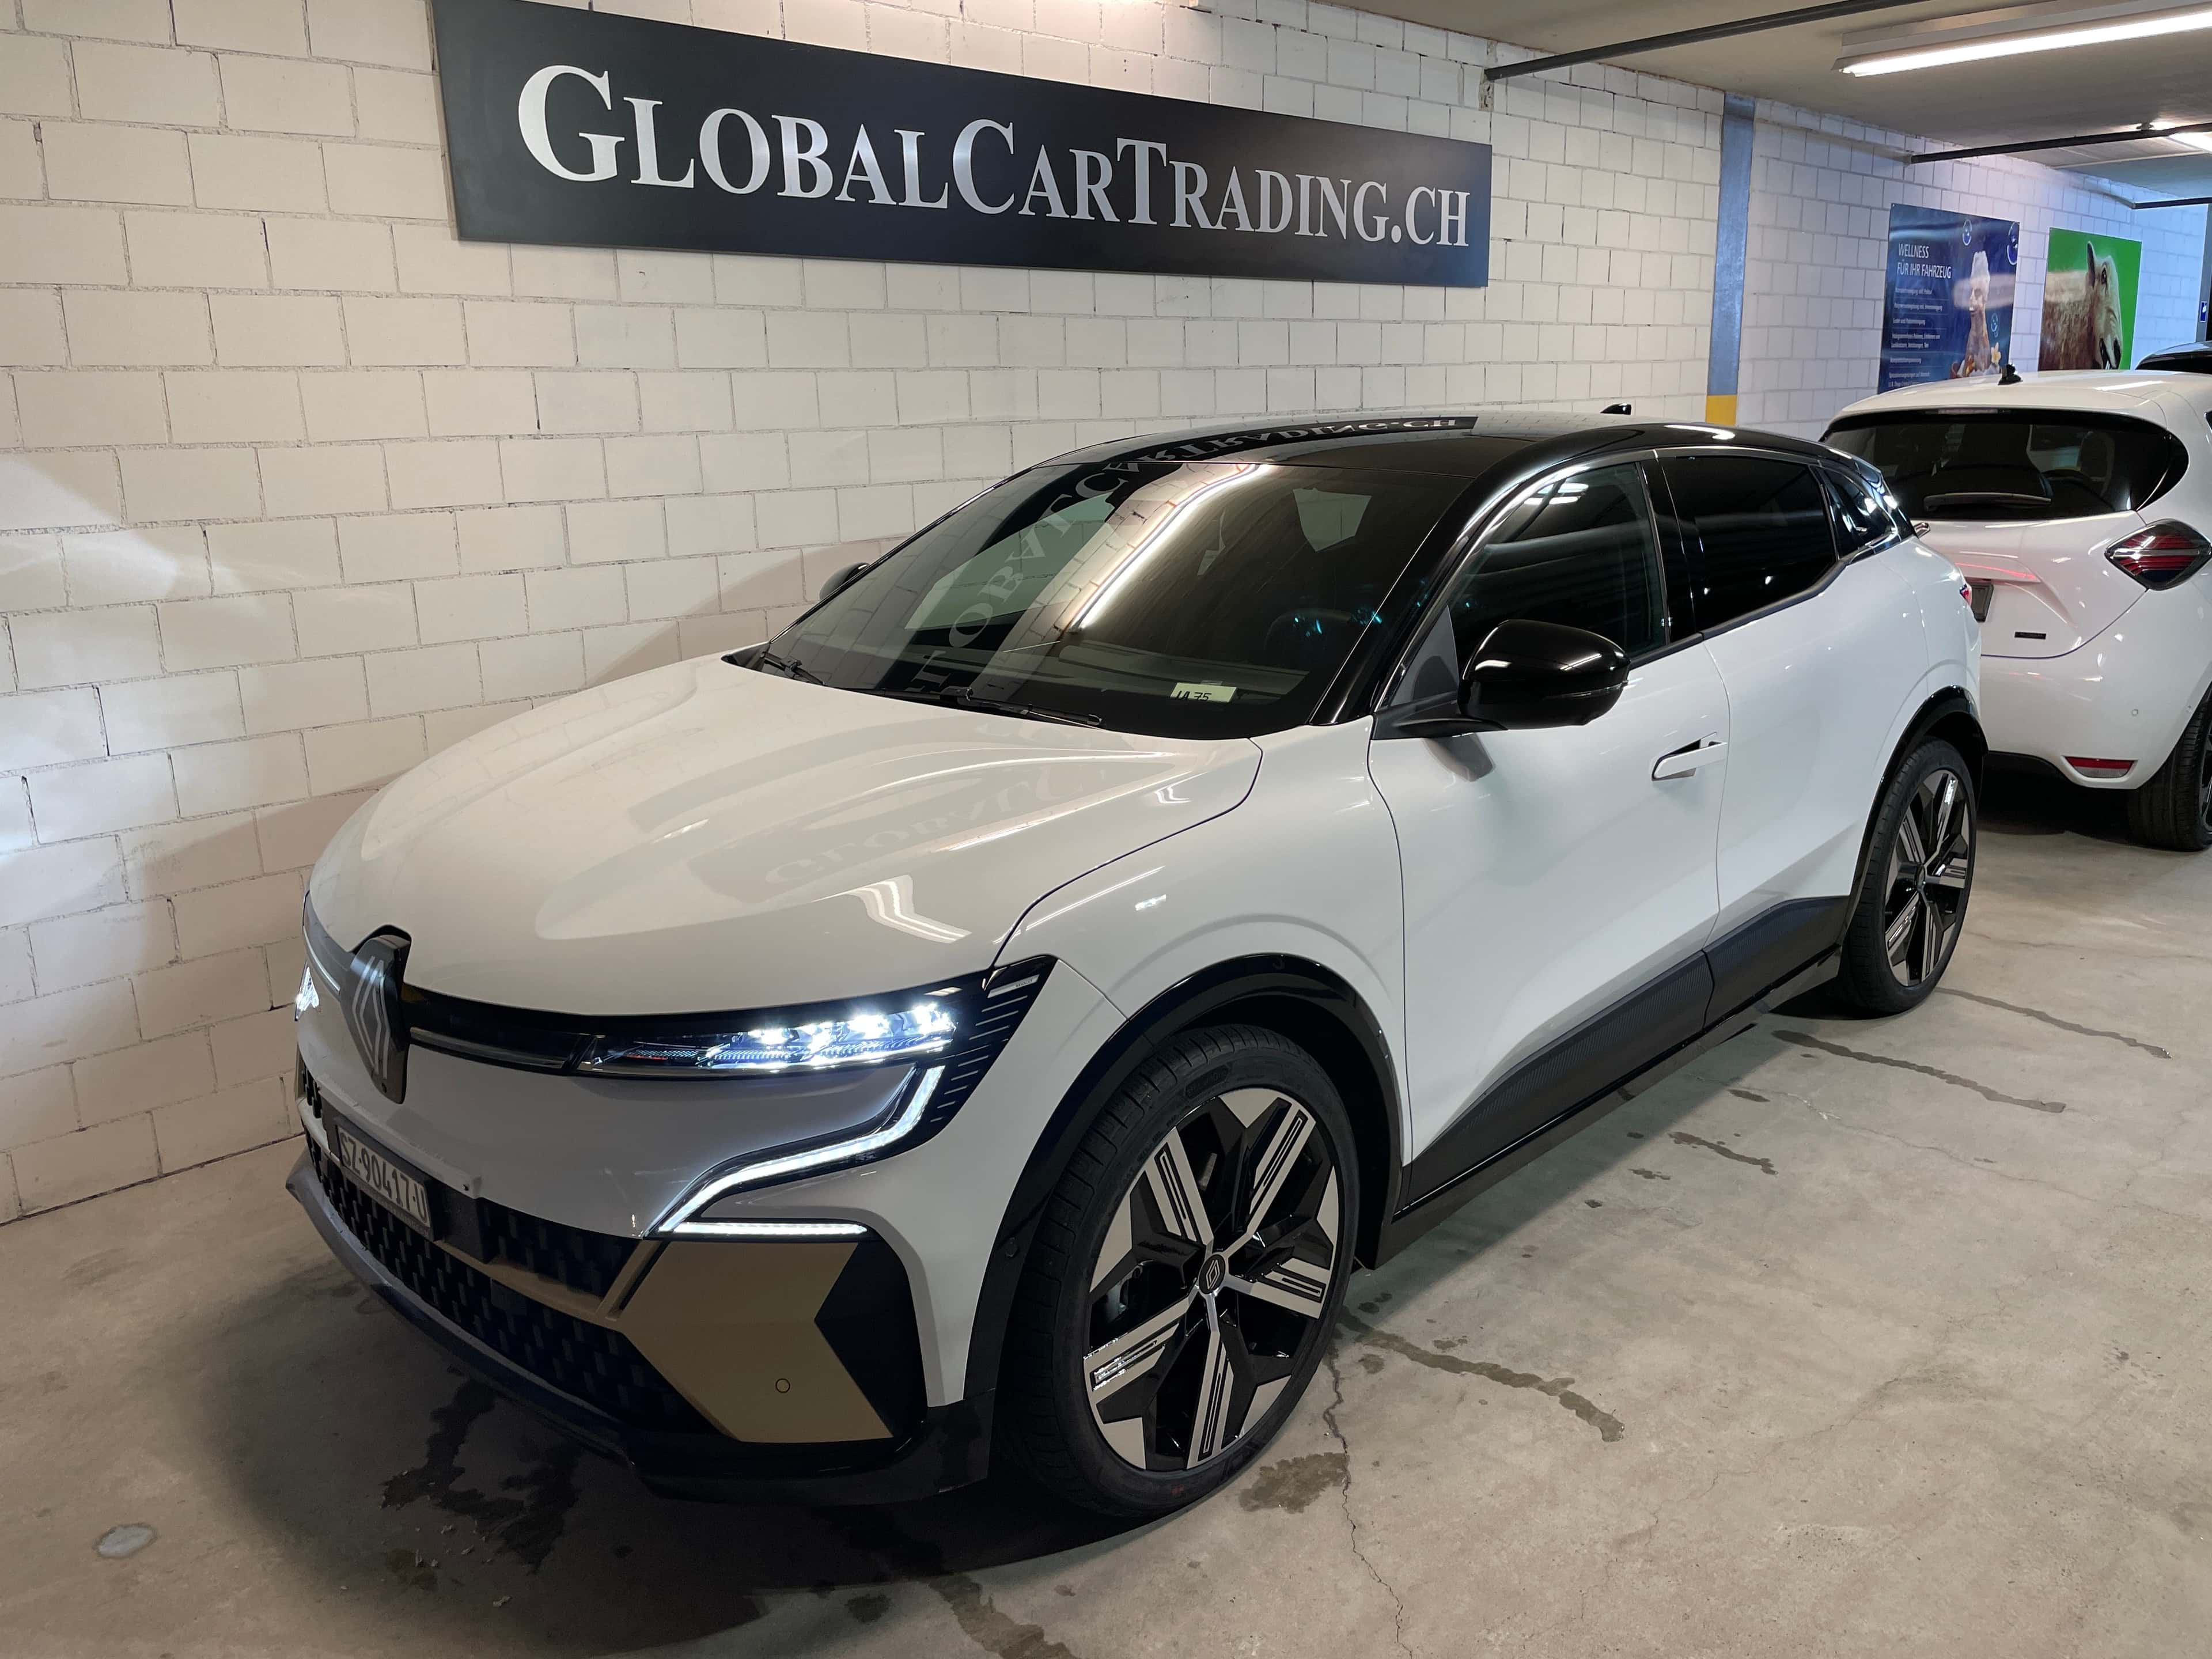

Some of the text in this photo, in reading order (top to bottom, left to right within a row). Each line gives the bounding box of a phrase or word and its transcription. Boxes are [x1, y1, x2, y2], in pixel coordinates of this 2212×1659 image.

[518, 65, 1471, 247] GLOBALCARTRADING.CH
[1898, 243, 1930, 259] WELLNESS
[1897, 259, 1952, 279] FÜR IHR FAHRZEUG
